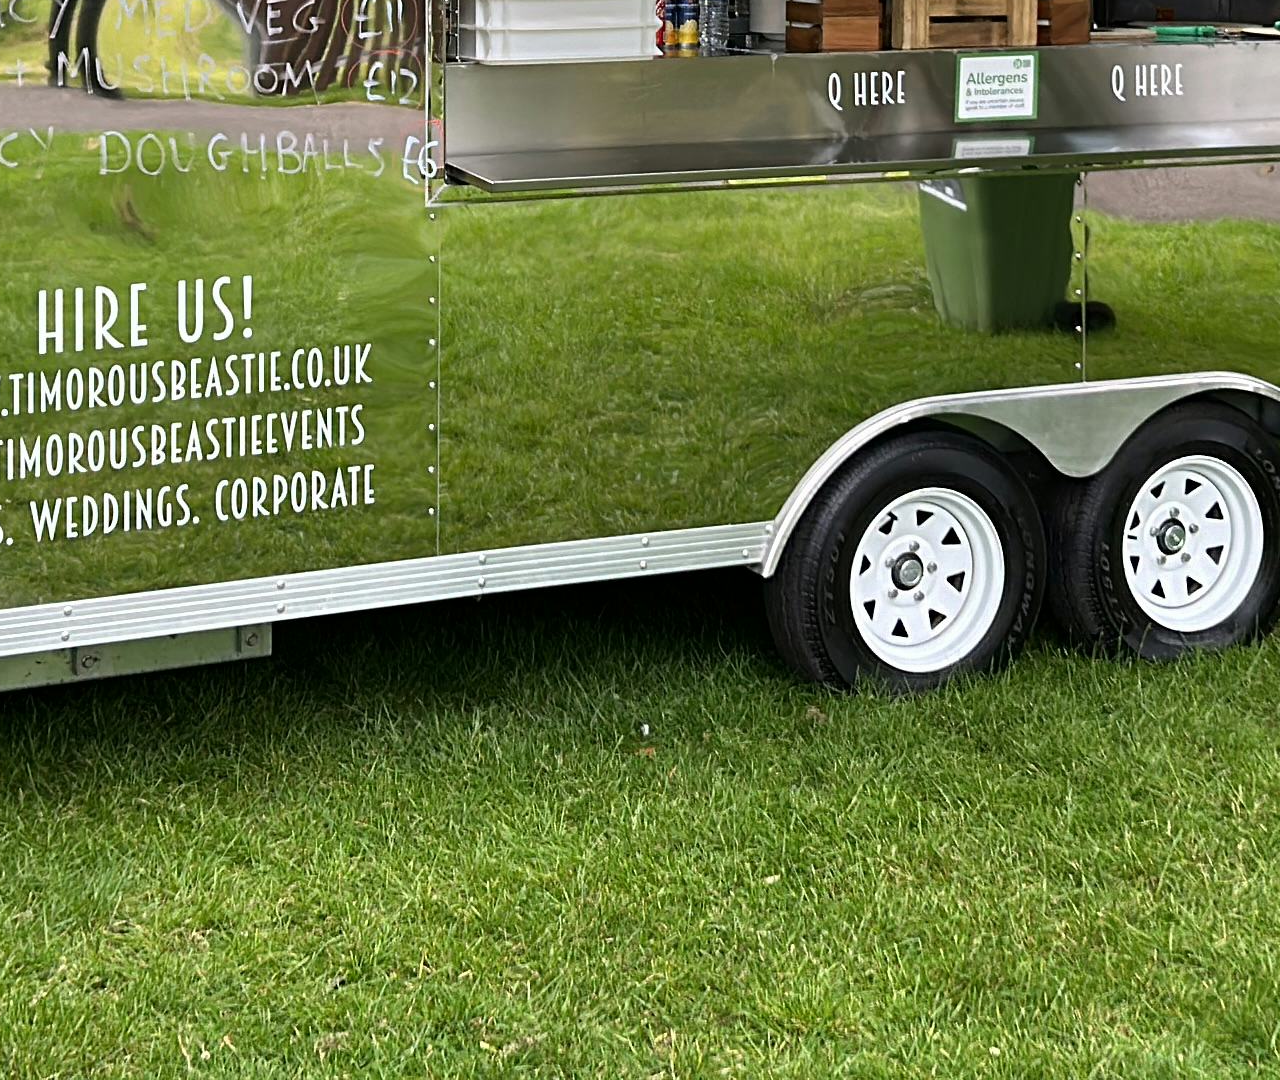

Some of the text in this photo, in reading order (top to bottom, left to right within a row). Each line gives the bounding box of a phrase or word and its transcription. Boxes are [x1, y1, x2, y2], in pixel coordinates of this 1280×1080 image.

[57, 47, 321, 106] MUSHROOM
[827, 71, 906, 111] Q HERE
[966, 72, 1028, 86] Allergens
[974, 87, 1024, 96] Intolerances
[1111, 63, 1184, 101] Q HERE
[99, 124, 384, 180] DOUGHBALLS
[37, 275, 254, 355] HIRE US!
[30, 483, 200, 542] WEDDINGS.
[215, 464, 376, 522] CORPORATE
